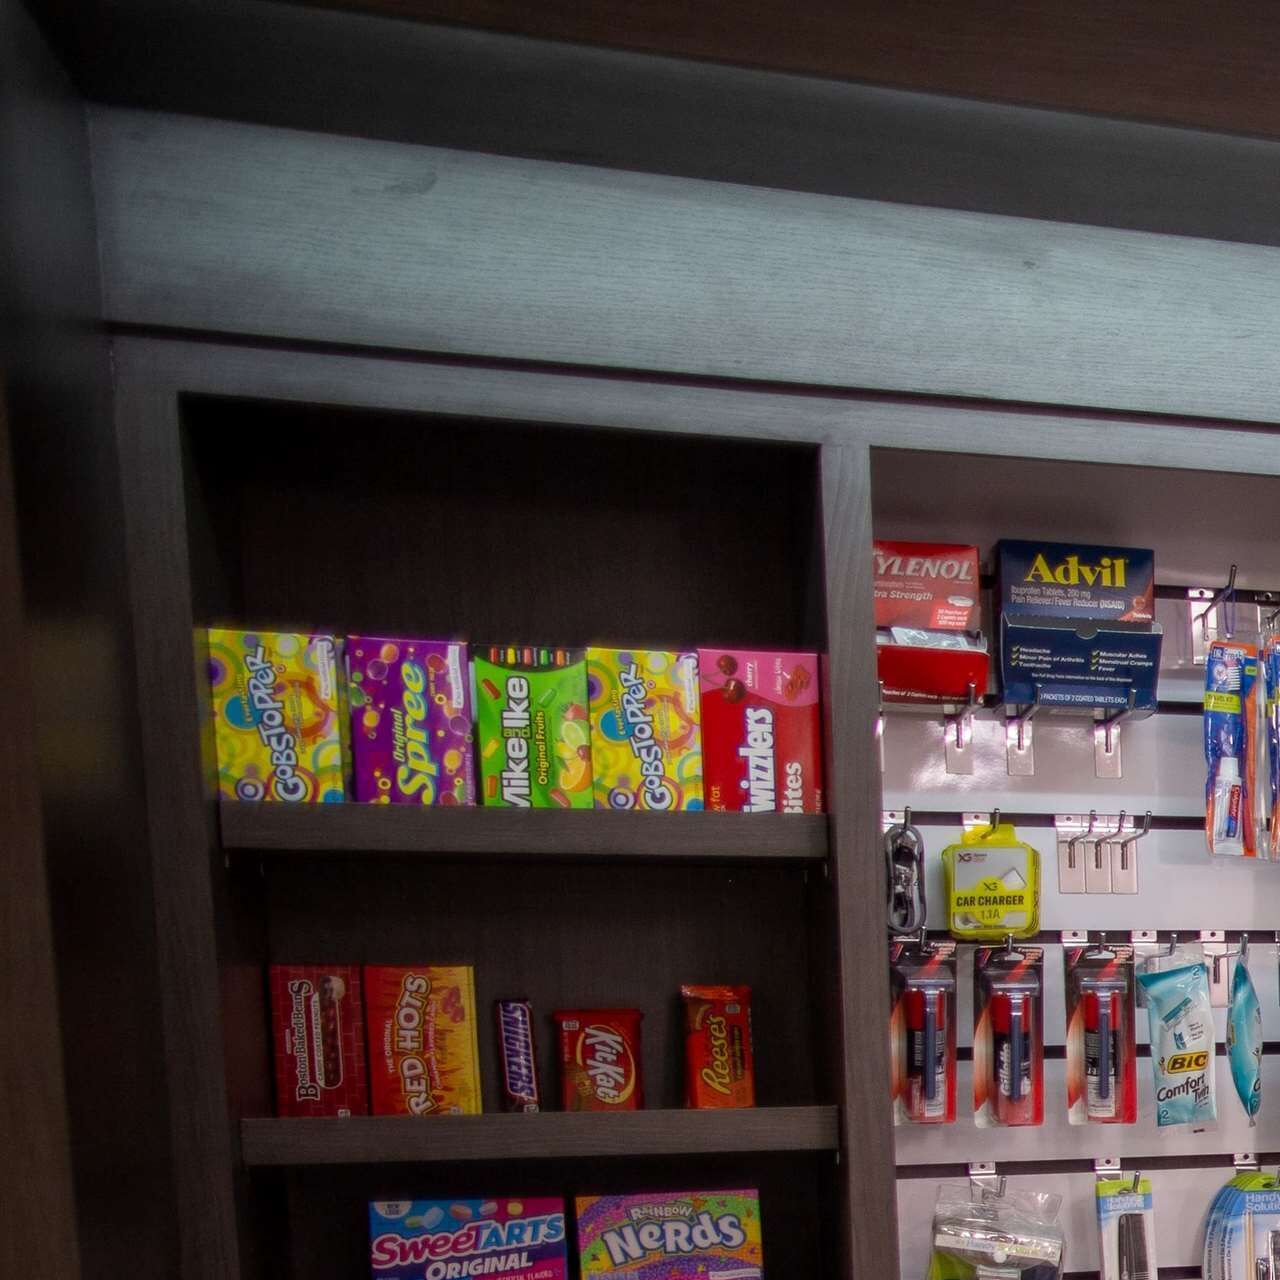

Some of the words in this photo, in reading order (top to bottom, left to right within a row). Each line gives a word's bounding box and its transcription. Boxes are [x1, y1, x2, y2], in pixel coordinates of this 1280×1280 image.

[1024, 554, 1127, 588] Advil
[889, 591, 933, 601] Strength
[397, 659, 441, 806] Spree
[502, 727, 530, 738] and
[537, 710, 547, 739] Fruits
[537, 740, 549, 786] Original
[957, 895, 976, 907] CAR
[977, 894, 1024, 906] CHARGER
[397, 975, 430, 1050] HOTS
[293, 1020, 306, 1055] Baked
[501, 1001, 534, 1101] SNICKERS
[702, 1014, 732, 1095] Reese's
[298, 1056, 319, 1101] Boston
[1170, 1053, 1206, 1071] BIC
[401, 1056, 435, 1114] RED
[1157, 1073, 1205, 1102] Comfort
